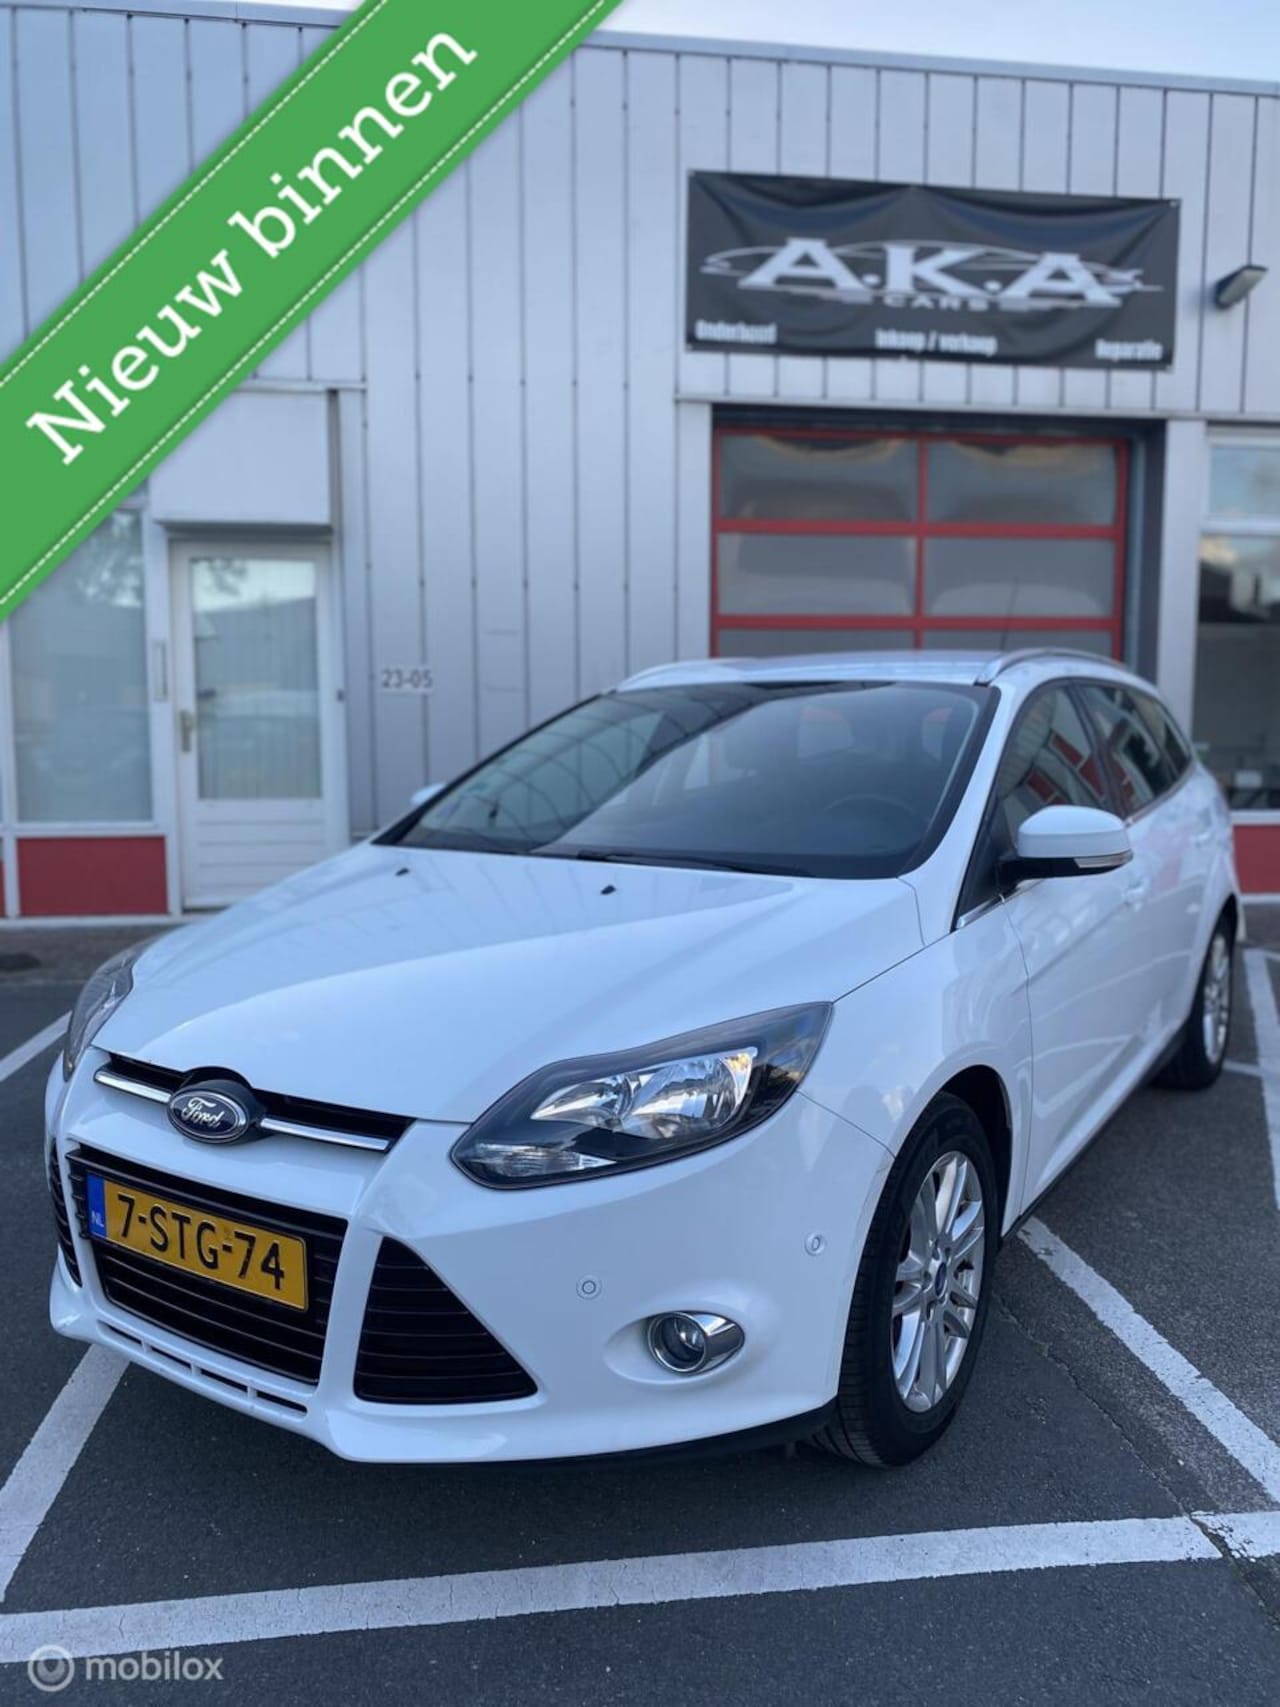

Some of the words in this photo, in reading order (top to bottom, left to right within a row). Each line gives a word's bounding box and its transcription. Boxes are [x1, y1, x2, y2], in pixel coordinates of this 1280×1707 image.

[738, 237, 1121, 308] A.K.A
[884, 294, 988, 311] CARS
[695, 319, 777, 345] Onderhoud
[940, 332, 998, 357] verkoop
[1095, 338, 1163, 362] Reparatie
[382, 668, 433, 688] 23-05
[180, 1097, 225, 1128] Ford
[91, 1210, 104, 1227] NL
[117, 1193, 285, 1290] 7-STG-74
